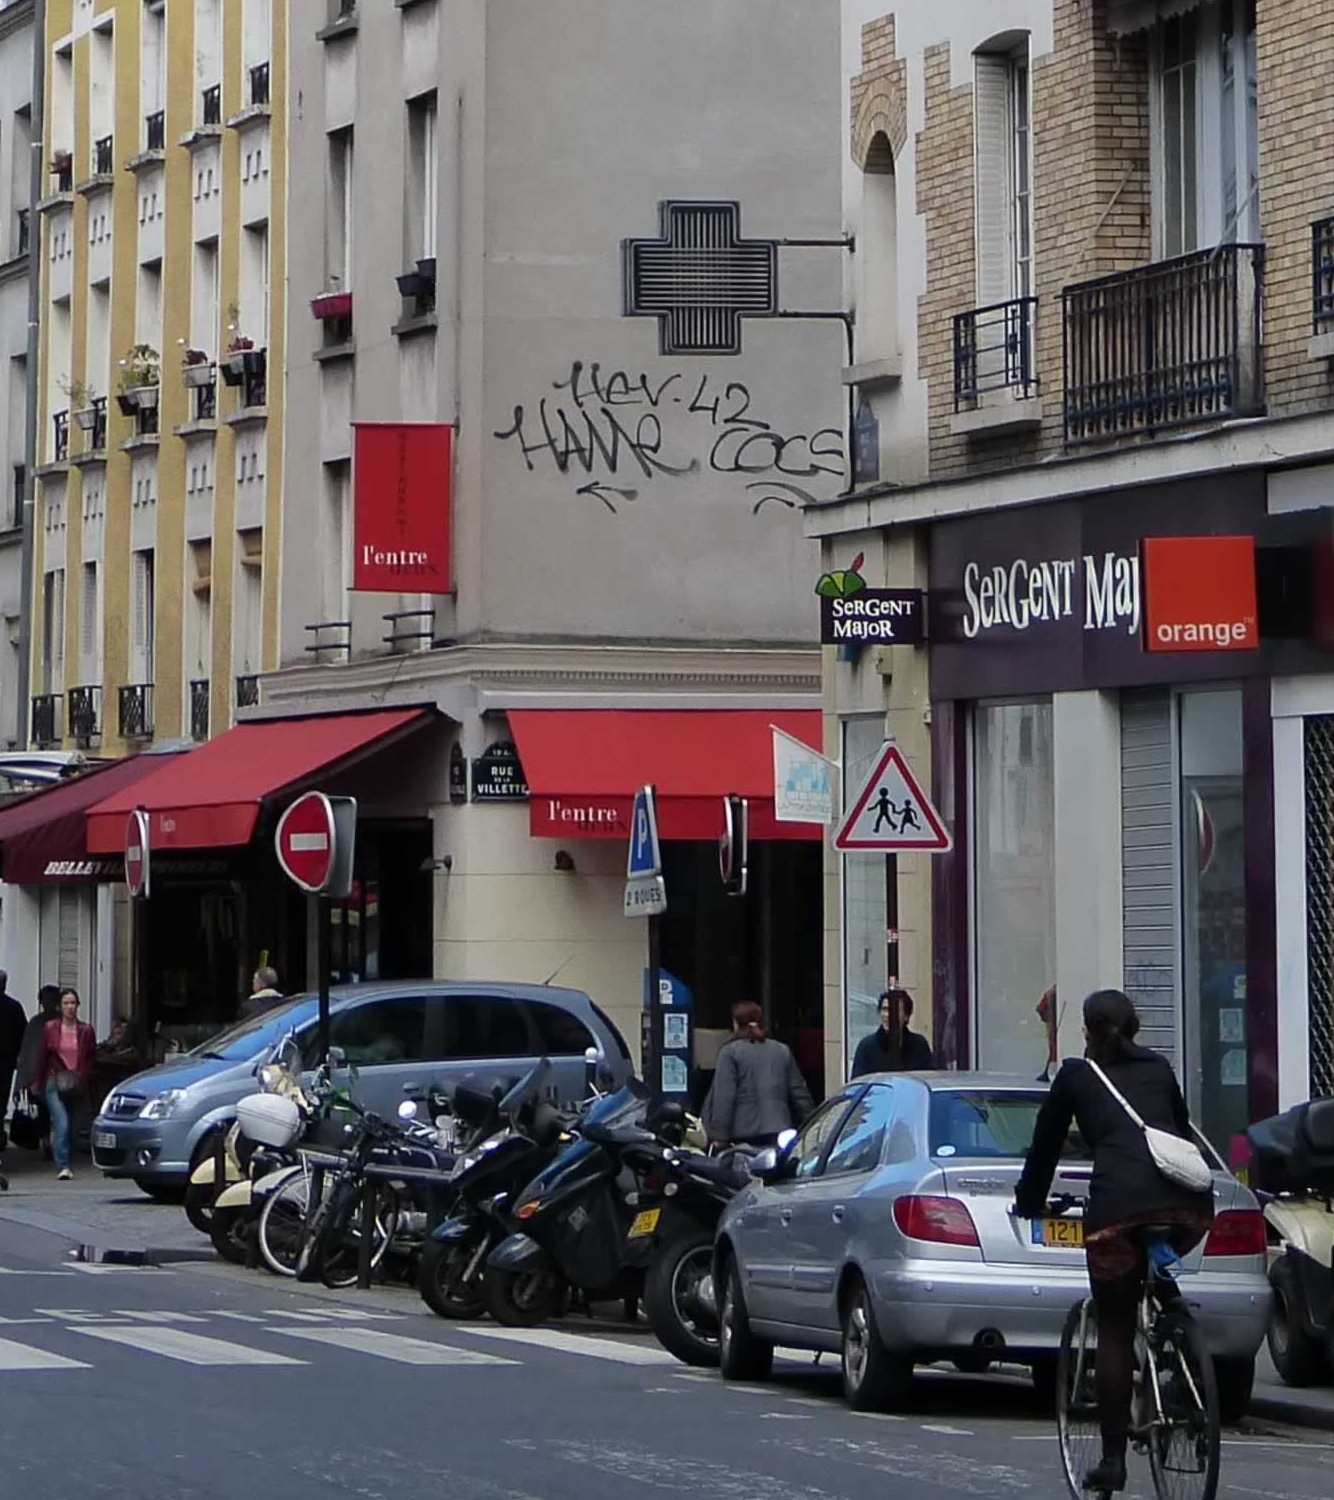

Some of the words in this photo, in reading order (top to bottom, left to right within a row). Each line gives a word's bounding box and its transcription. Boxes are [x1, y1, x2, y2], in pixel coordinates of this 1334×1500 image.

[363, 545, 428, 565] l'entre
[491, 766, 514, 776] RUE
[477, 784, 527, 794] VILLETTE
[549, 801, 618, 822] l'entre
[634, 887, 661, 905] ROUES
